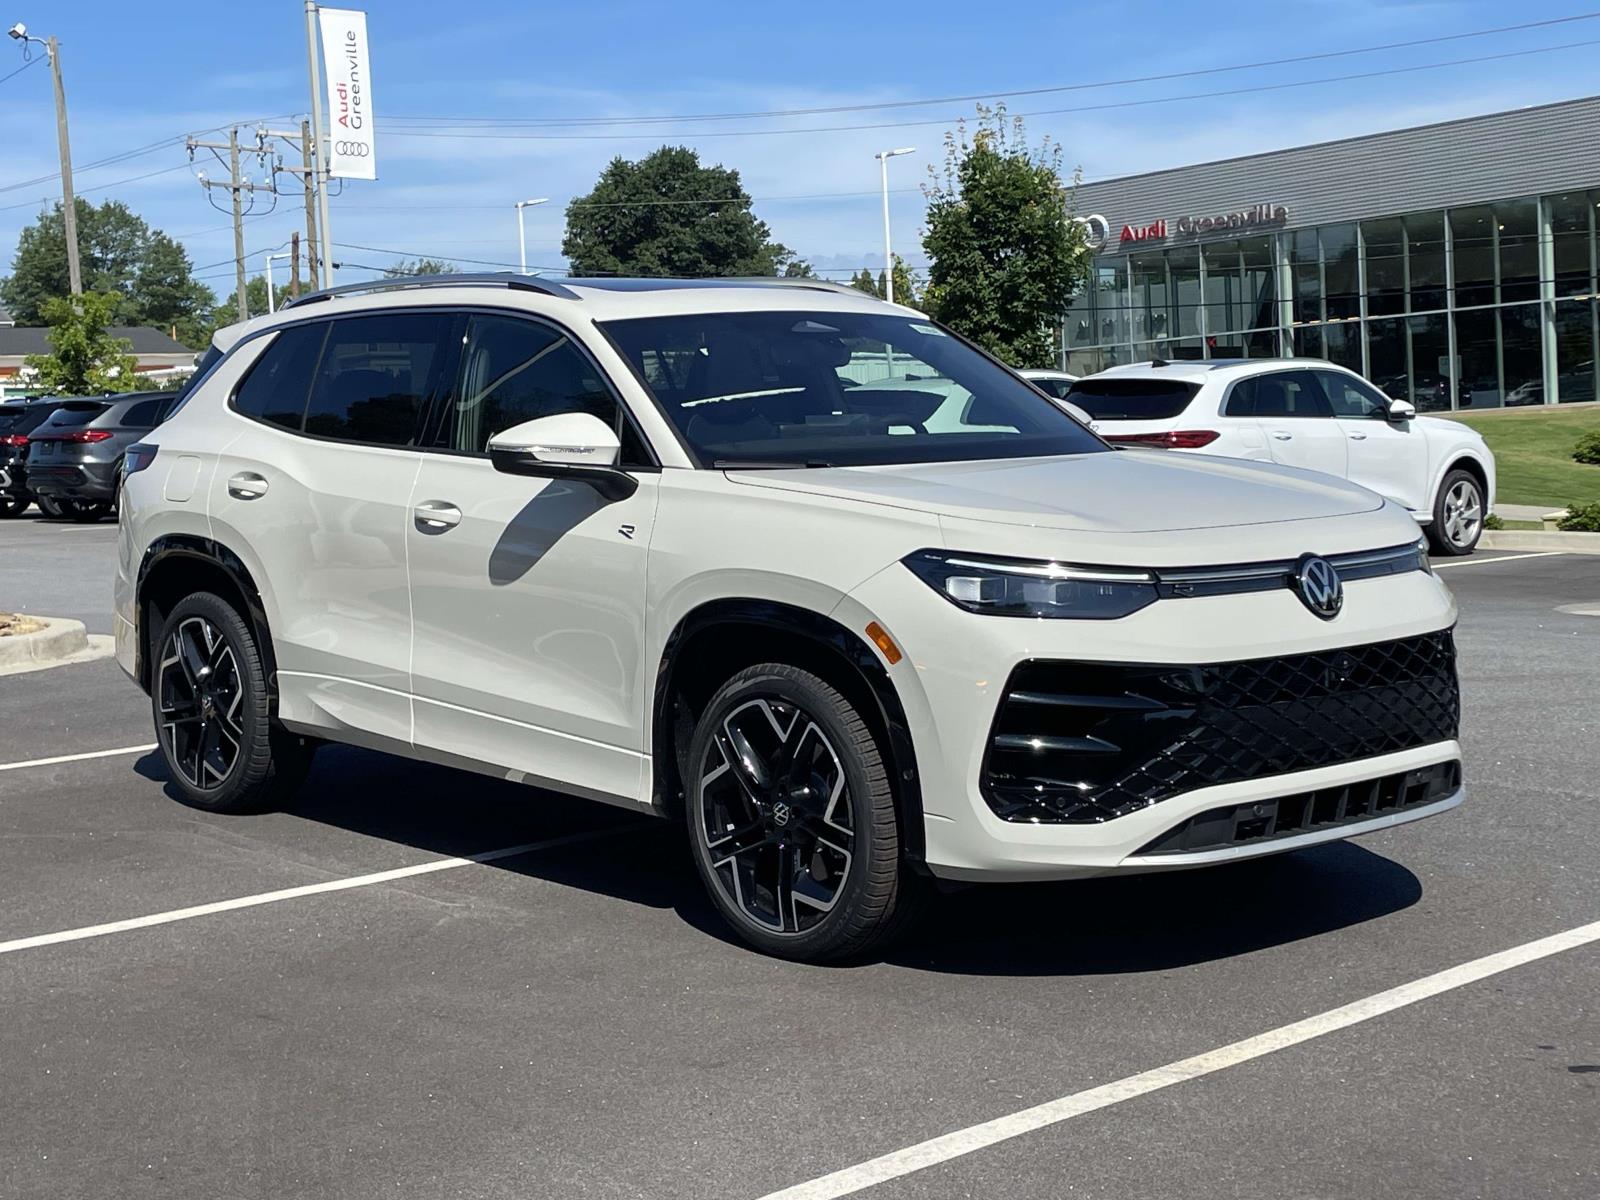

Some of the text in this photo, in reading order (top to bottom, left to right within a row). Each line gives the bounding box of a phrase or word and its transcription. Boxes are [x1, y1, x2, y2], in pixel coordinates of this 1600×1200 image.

[345, 30, 362, 130] Greenville
[336, 82, 348, 128] Audi
[1120, 203, 1289, 241] Audi Greenville
